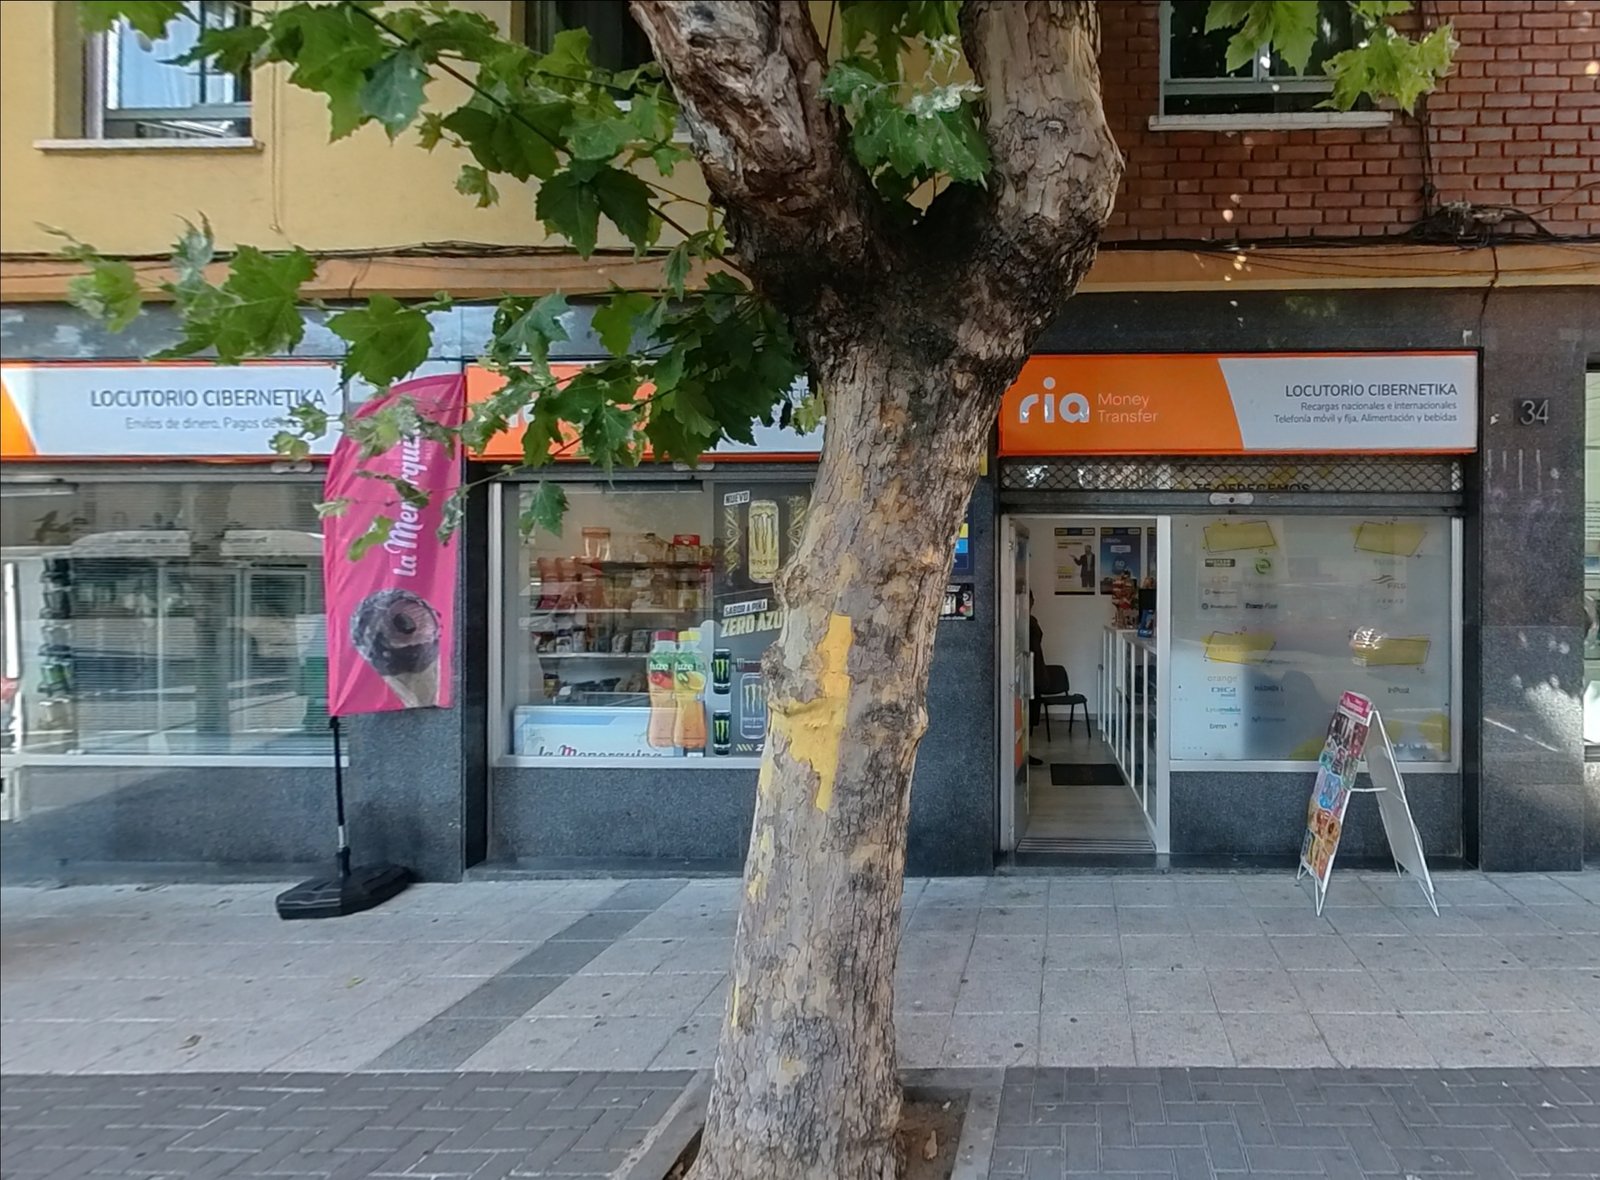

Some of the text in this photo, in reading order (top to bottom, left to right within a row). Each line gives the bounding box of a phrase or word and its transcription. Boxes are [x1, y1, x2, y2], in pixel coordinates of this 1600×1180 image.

[1285, 383, 1458, 397] LOCUTORIO CIBERNETIKA
[91, 389, 326, 407] LOCUTORIO CIBERNETIKA
[1019, 377, 1090, 424] ria
[1098, 393, 1150, 408] Money
[1301, 402, 1340, 412] Recargas
[1342, 401, 1385, 411] nacionales
[1387, 402, 1393, 410] e
[1520, 399, 1549, 425] 34
[165, 417, 180, 430] de
[223, 416, 259, 432] Pagos
[1098, 409, 1159, 424] Transfer
[1361, 412, 1415, 422] Alimentación
[1424, 412, 1457, 422] bebidas
[720, 613, 755, 637] ZERO
